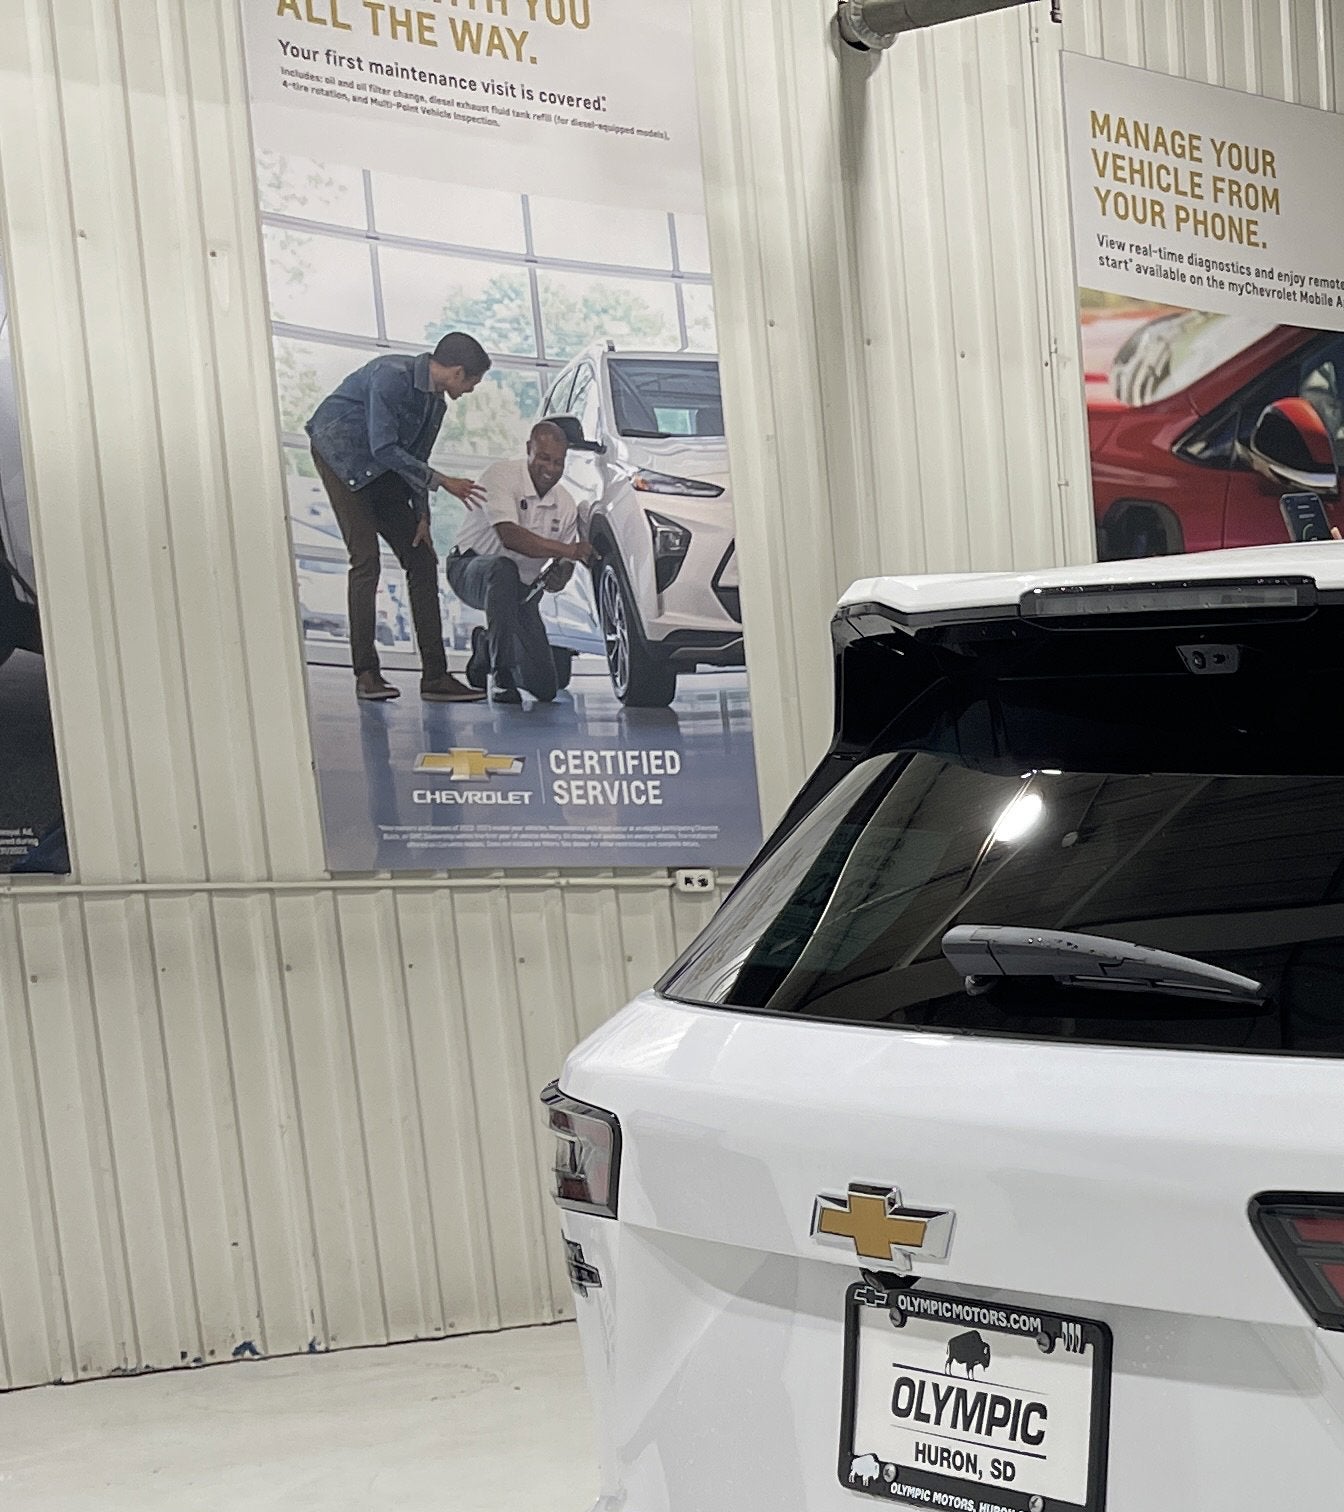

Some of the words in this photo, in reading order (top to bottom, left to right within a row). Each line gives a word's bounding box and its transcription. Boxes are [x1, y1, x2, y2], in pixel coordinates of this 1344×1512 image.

[277, 0, 352, 31] ALL
[363, 2, 438, 47] THE
[449, 17, 537, 64] WAY.
[525, 0, 590, 29] YOU
[277, 38, 319, 62] Your
[325, 49, 364, 72] first
[369, 61, 477, 92] maintenance
[481, 79, 516, 98] visit
[521, 84, 534, 101] is
[1090, 110, 1202, 164] MANAGE
[1209, 138, 1277, 178] YOUR
[1091, 148, 1204, 200] VEHICLE
[1212, 175, 1281, 216] FROM
[1094, 186, 1166, 229] YOUR
[1175, 204, 1267, 248] PHONE.
[1097, 233, 1125, 252] View
[1128, 242, 1184, 265] real-time
[1187, 253, 1252, 278] diagnostics
[1254, 265, 1275, 281] and
[1277, 269, 1306, 289] enjoy
[1135, 262, 1186, 283] available
[1189, 273, 1204, 286] on
[1206, 274, 1225, 291] the
[1228, 280, 1298, 302] myChevrolet
[1300, 290, 1333, 308] Mobile
[549, 749, 681, 775] CERTIFIED
[412, 789, 533, 805] CHEVROLET
[553, 780, 663, 805] SERVICE
[891, 1376, 1048, 1446] OLYMPIC
[914, 1441, 983, 1480] HURON,
[990, 1458, 1016, 1482] SD
[890, 1482, 931, 1503] OLYMPIC
